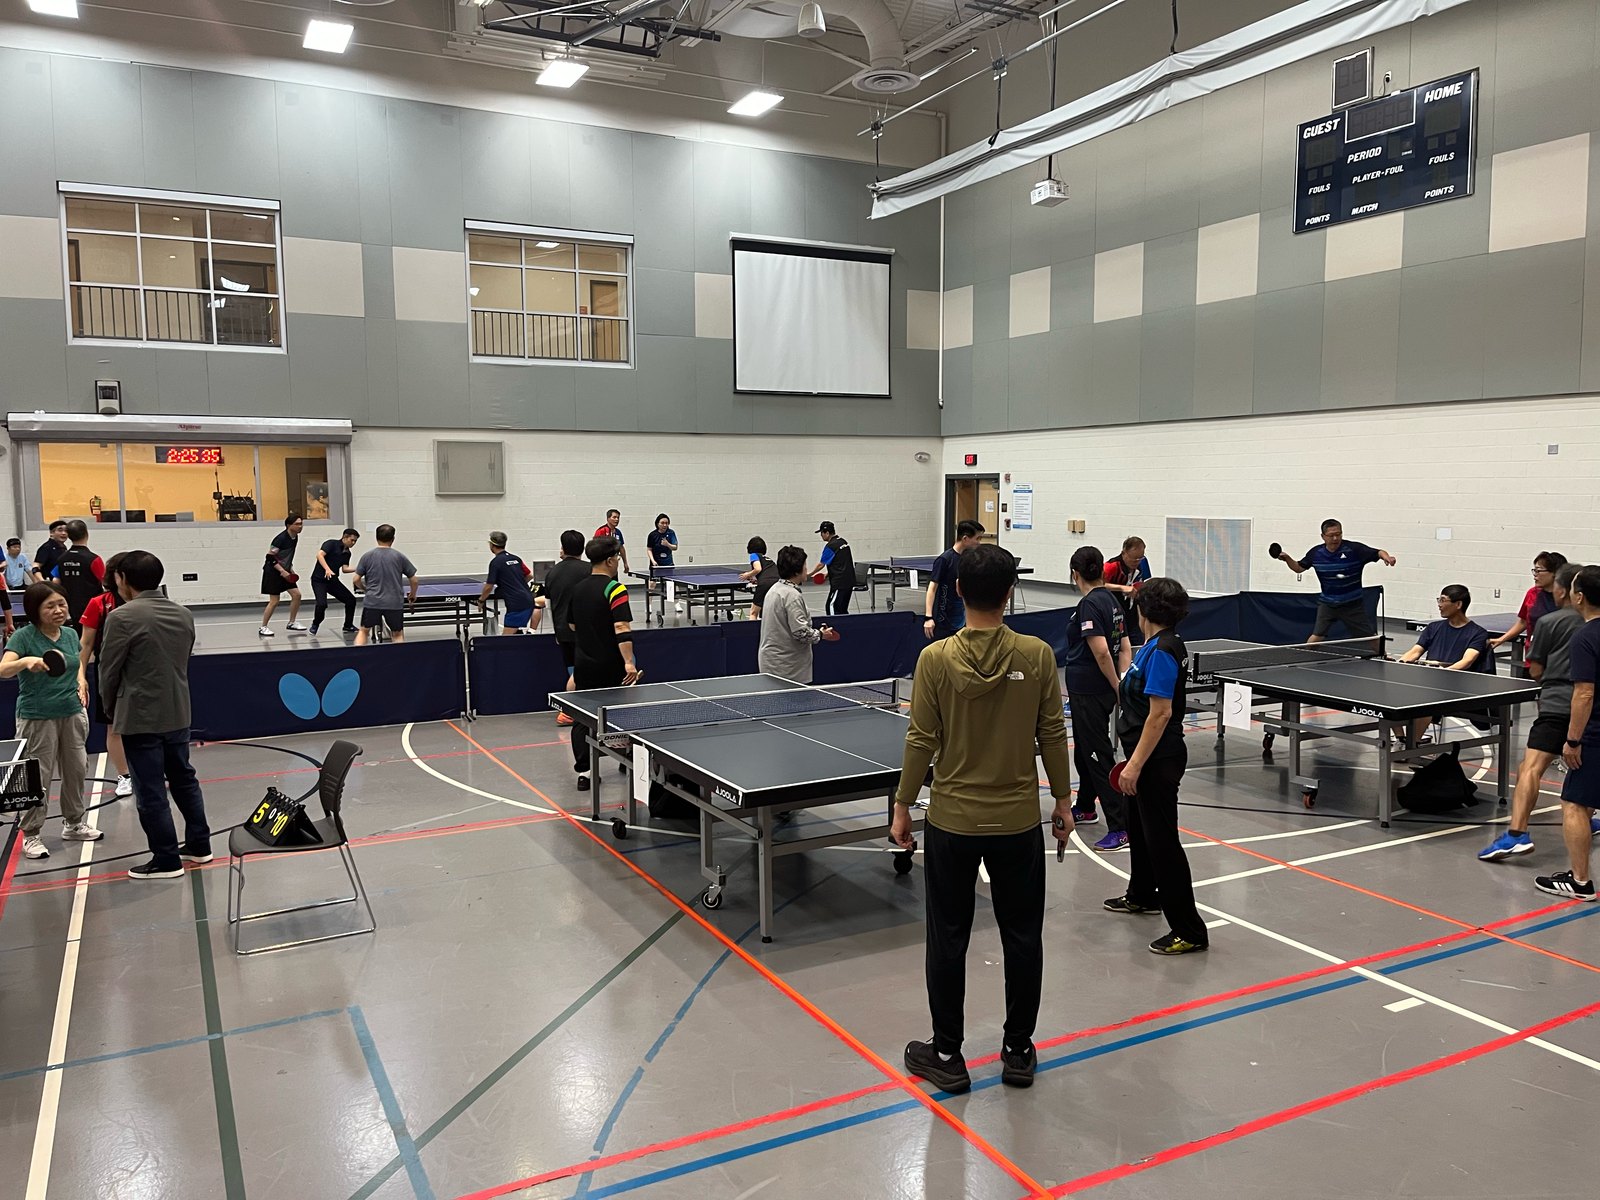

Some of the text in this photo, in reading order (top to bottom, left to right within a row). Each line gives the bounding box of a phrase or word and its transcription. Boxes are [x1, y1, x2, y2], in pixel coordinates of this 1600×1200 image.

[1424, 81, 1463, 103] HOME
[1303, 118, 1340, 139] GUEST
[1347, 146, 1382, 164] PERIOD
[1428, 152, 1455, 165] FOULS
[1352, 165, 1404, 184] PLAYER-FOUL
[1308, 183, 1331, 195] FOULS
[1424, 185, 1455, 199] POINTS
[1351, 203, 1378, 215] MATCH
[1305, 213, 1330, 226] POINTS
[168, 448, 220, 463] 2:25 35
[1232, 690, 1244, 716] 3
[1357, 708, 1384, 718] JOOLA
[640, 757, 647, 783] 2
[10, 795, 39, 803] JOOLA
[719, 788, 736, 803] JOOLA
[253, 802, 270, 824] 5
